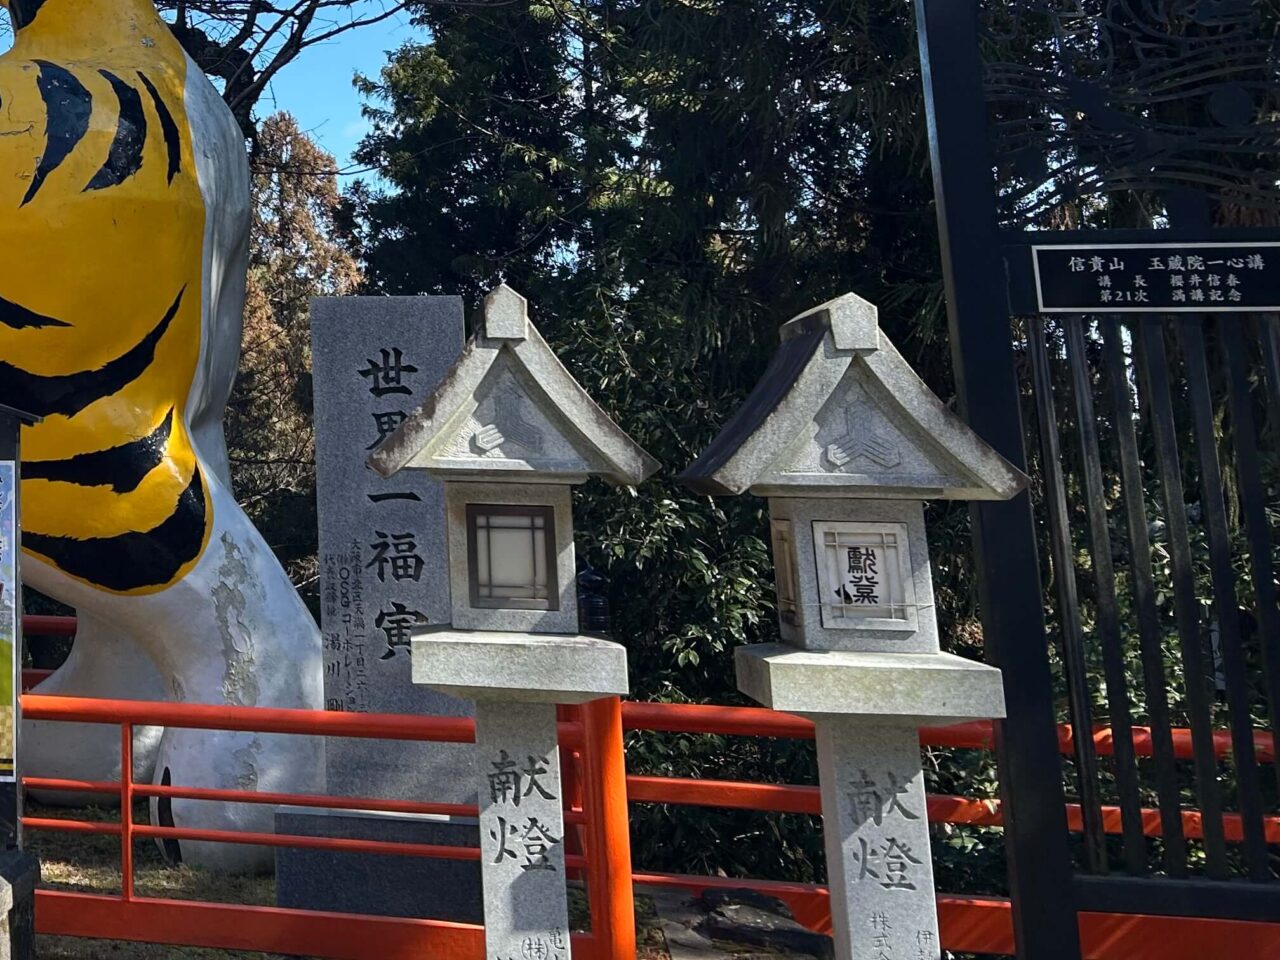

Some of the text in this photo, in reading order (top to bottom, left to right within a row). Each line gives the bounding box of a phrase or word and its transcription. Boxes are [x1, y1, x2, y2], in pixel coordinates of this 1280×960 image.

[1068, 256, 1125, 272] 信貴山
[1100, 289, 1149, 303] 第21次
[487, 749, 561, 872] 献燈
[847, 768, 925, 891] 献燈
[871, 911, 893, 960] 株式
